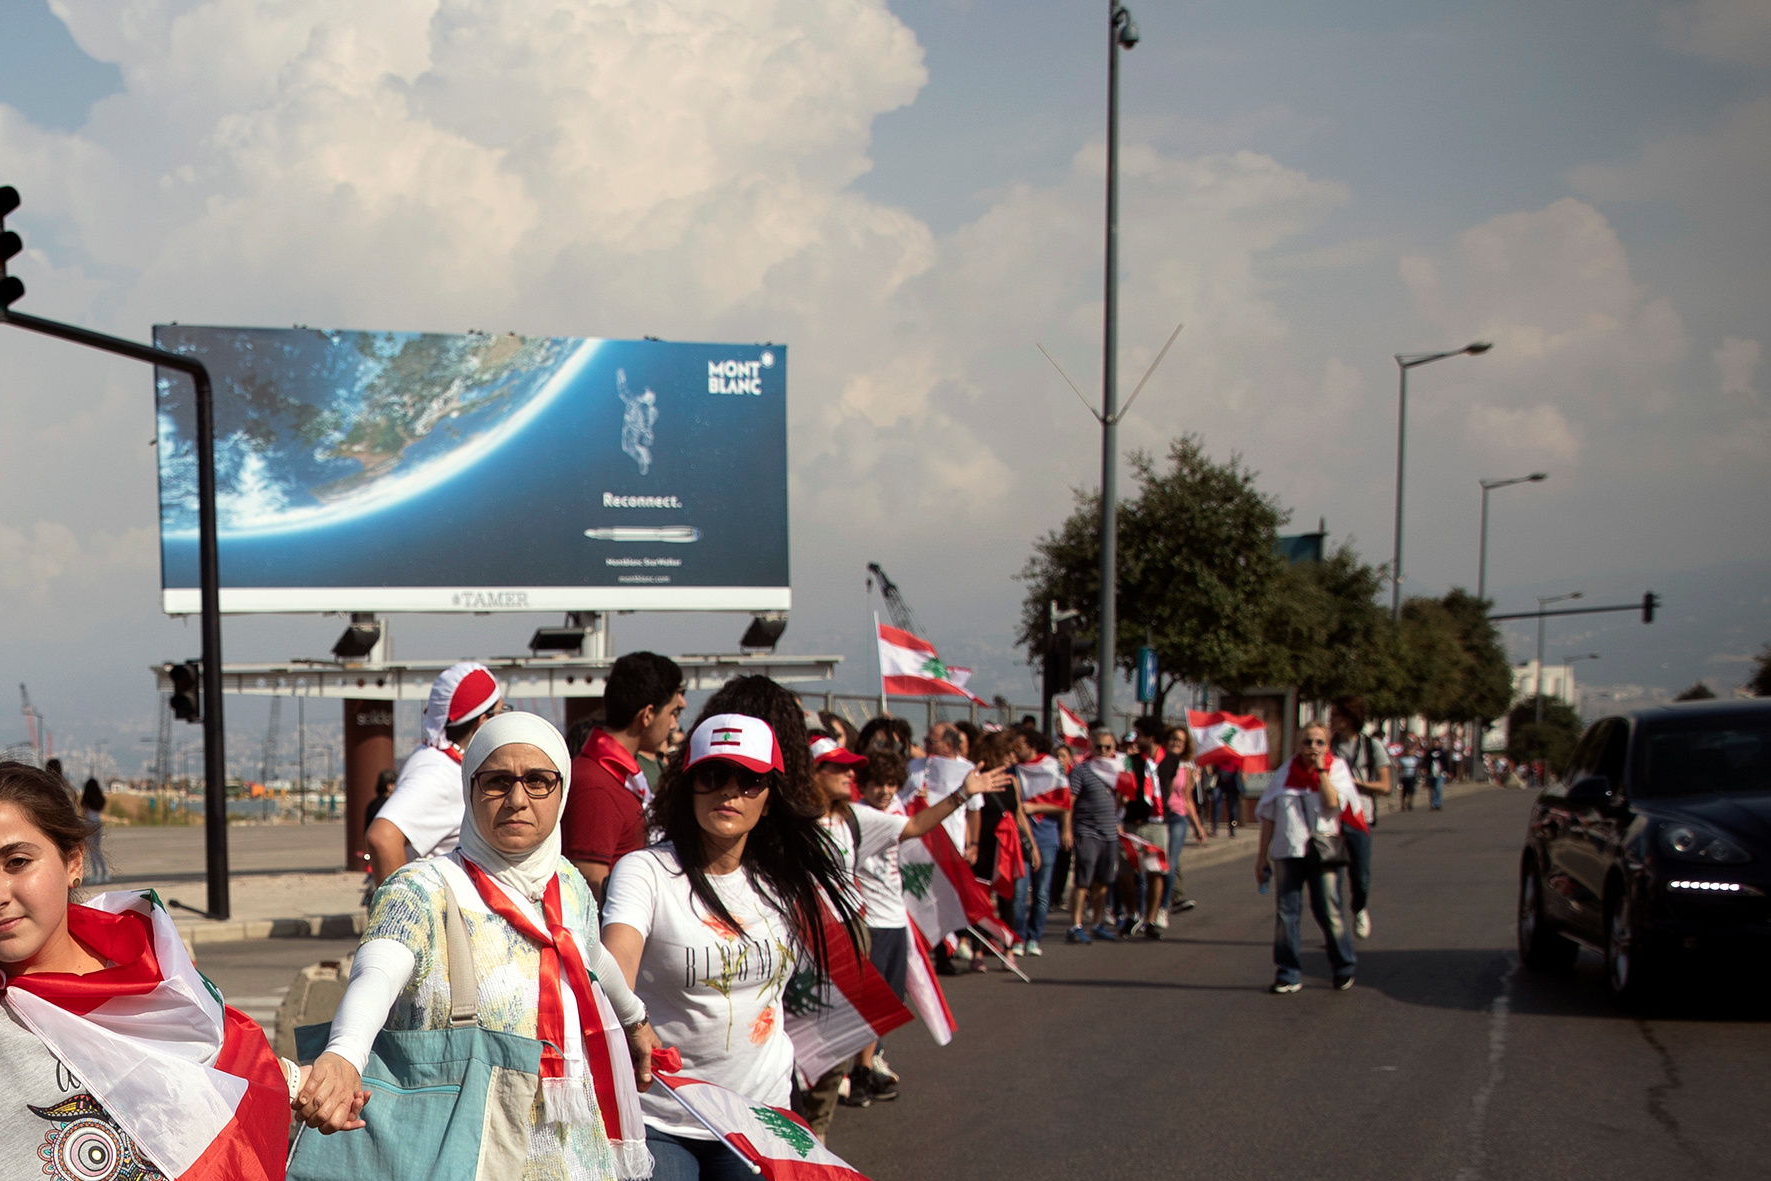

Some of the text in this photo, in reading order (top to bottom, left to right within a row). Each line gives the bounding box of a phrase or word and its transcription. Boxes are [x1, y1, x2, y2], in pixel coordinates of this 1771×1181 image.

[708, 360, 761, 378] MONT
[708, 377, 762, 395] BLANC
[603, 492, 682, 508] Reconnect.
